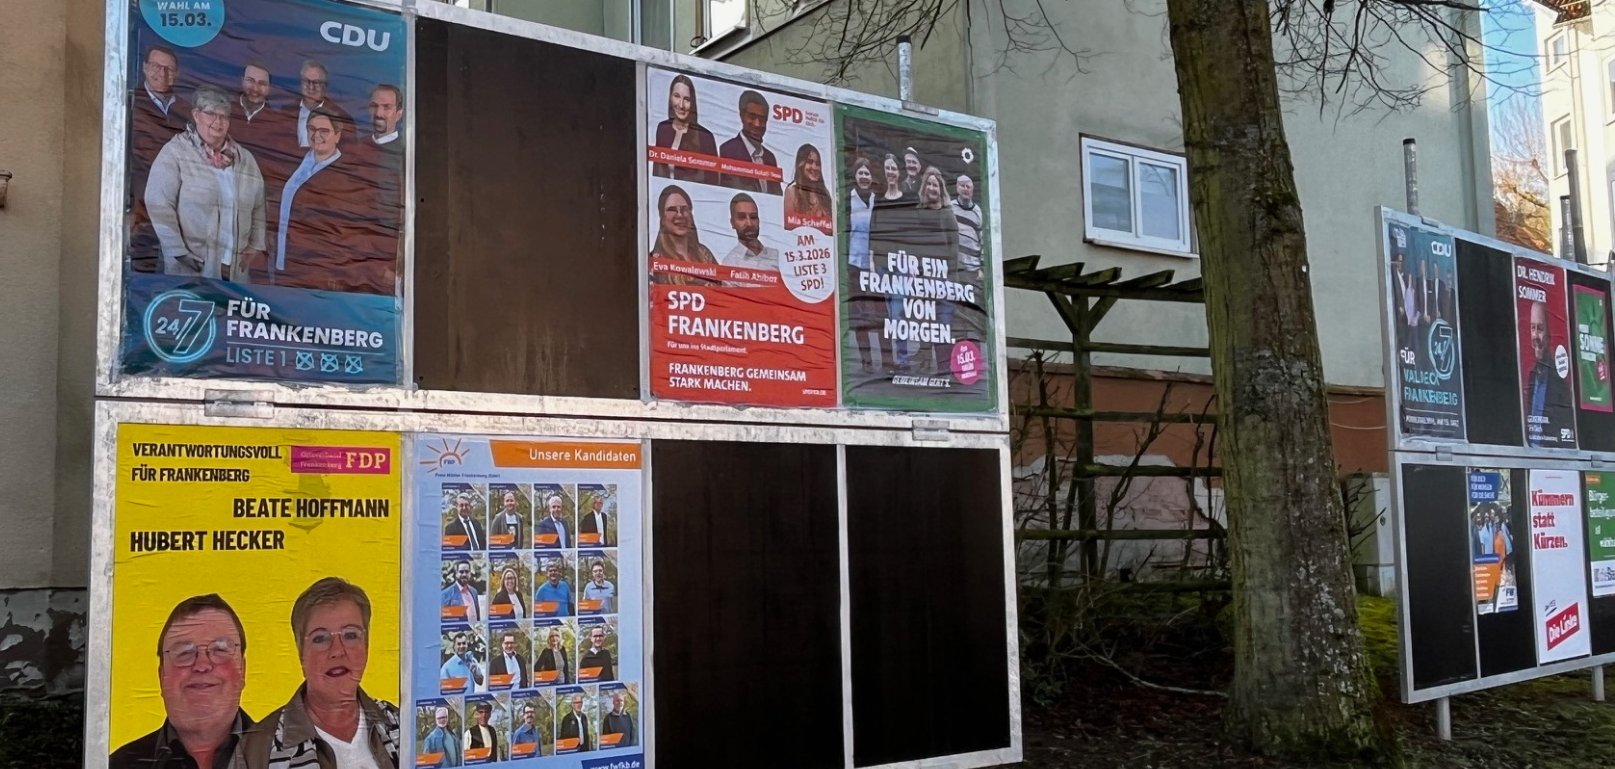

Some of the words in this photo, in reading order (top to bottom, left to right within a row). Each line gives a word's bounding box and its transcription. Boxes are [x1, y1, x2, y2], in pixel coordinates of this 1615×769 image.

[157, 1, 193, 11] WAHL
[194, 2, 211, 11] AM
[160, 13, 212, 28] 15.03.
[319, 20, 391, 52] CDU
[772, 104, 804, 124] SPD
[648, 149, 659, 158] Dr.
[660, 152, 686, 163] Daniela
[688, 156, 717, 166] Sommer
[787, 216, 800, 225] Mia
[797, 235, 815, 247] AM
[1431, 241, 1452, 258] CDU
[784, 248, 831, 263] 15.3.2026
[887, 251, 920, 275] FÜR
[922, 257, 948, 278] EIN
[653, 261, 668, 272] Eva
[669, 264, 717, 276] Kowalewski
[794, 266, 820, 277] LISTE
[821, 265, 828, 275] 3
[800, 278, 825, 292] SPD!
[859, 271, 975, 302] FRANKENBERG
[1518, 285, 1547, 303] SOMMER
[226, 296, 271, 320] FÜR
[667, 290, 705, 312] SPD
[903, 298, 937, 321] VON
[226, 319, 384, 349] FRANKENBERG
[668, 315, 804, 344] FRANKENBERG
[884, 318, 956, 344] MORGEN.
[667, 341, 677, 349] Für
[226, 347, 275, 367] LISTE
[280, 351, 286, 367] 1
[669, 363, 744, 378] FRANKENBERG
[746, 368, 806, 381] GEMEINSAM
[669, 376, 701, 389] STARK
[703, 378, 752, 392] MACHEN.
[132, 442, 282, 460] VERANTWORTUNGSVOLL
[345, 451, 386, 469] FDP
[529, 449, 572, 461] Unsere
[574, 449, 637, 463] Kandidaten
[131, 464, 157, 482] FÜR
[159, 468, 250, 482] FRANKENBERG
[1531, 489, 1575, 507] Kümmern
[233, 498, 292, 519] BEATE
[296, 498, 390, 518] HOFFMANN
[1533, 512, 1556, 528] statt
[130, 531, 208, 553] HUBERT
[212, 530, 285, 551] HECKER
[1534, 532, 1569, 550] Kürzen.
[1549, 623, 1560, 643] Die
[1560, 613, 1578, 635] Linke
